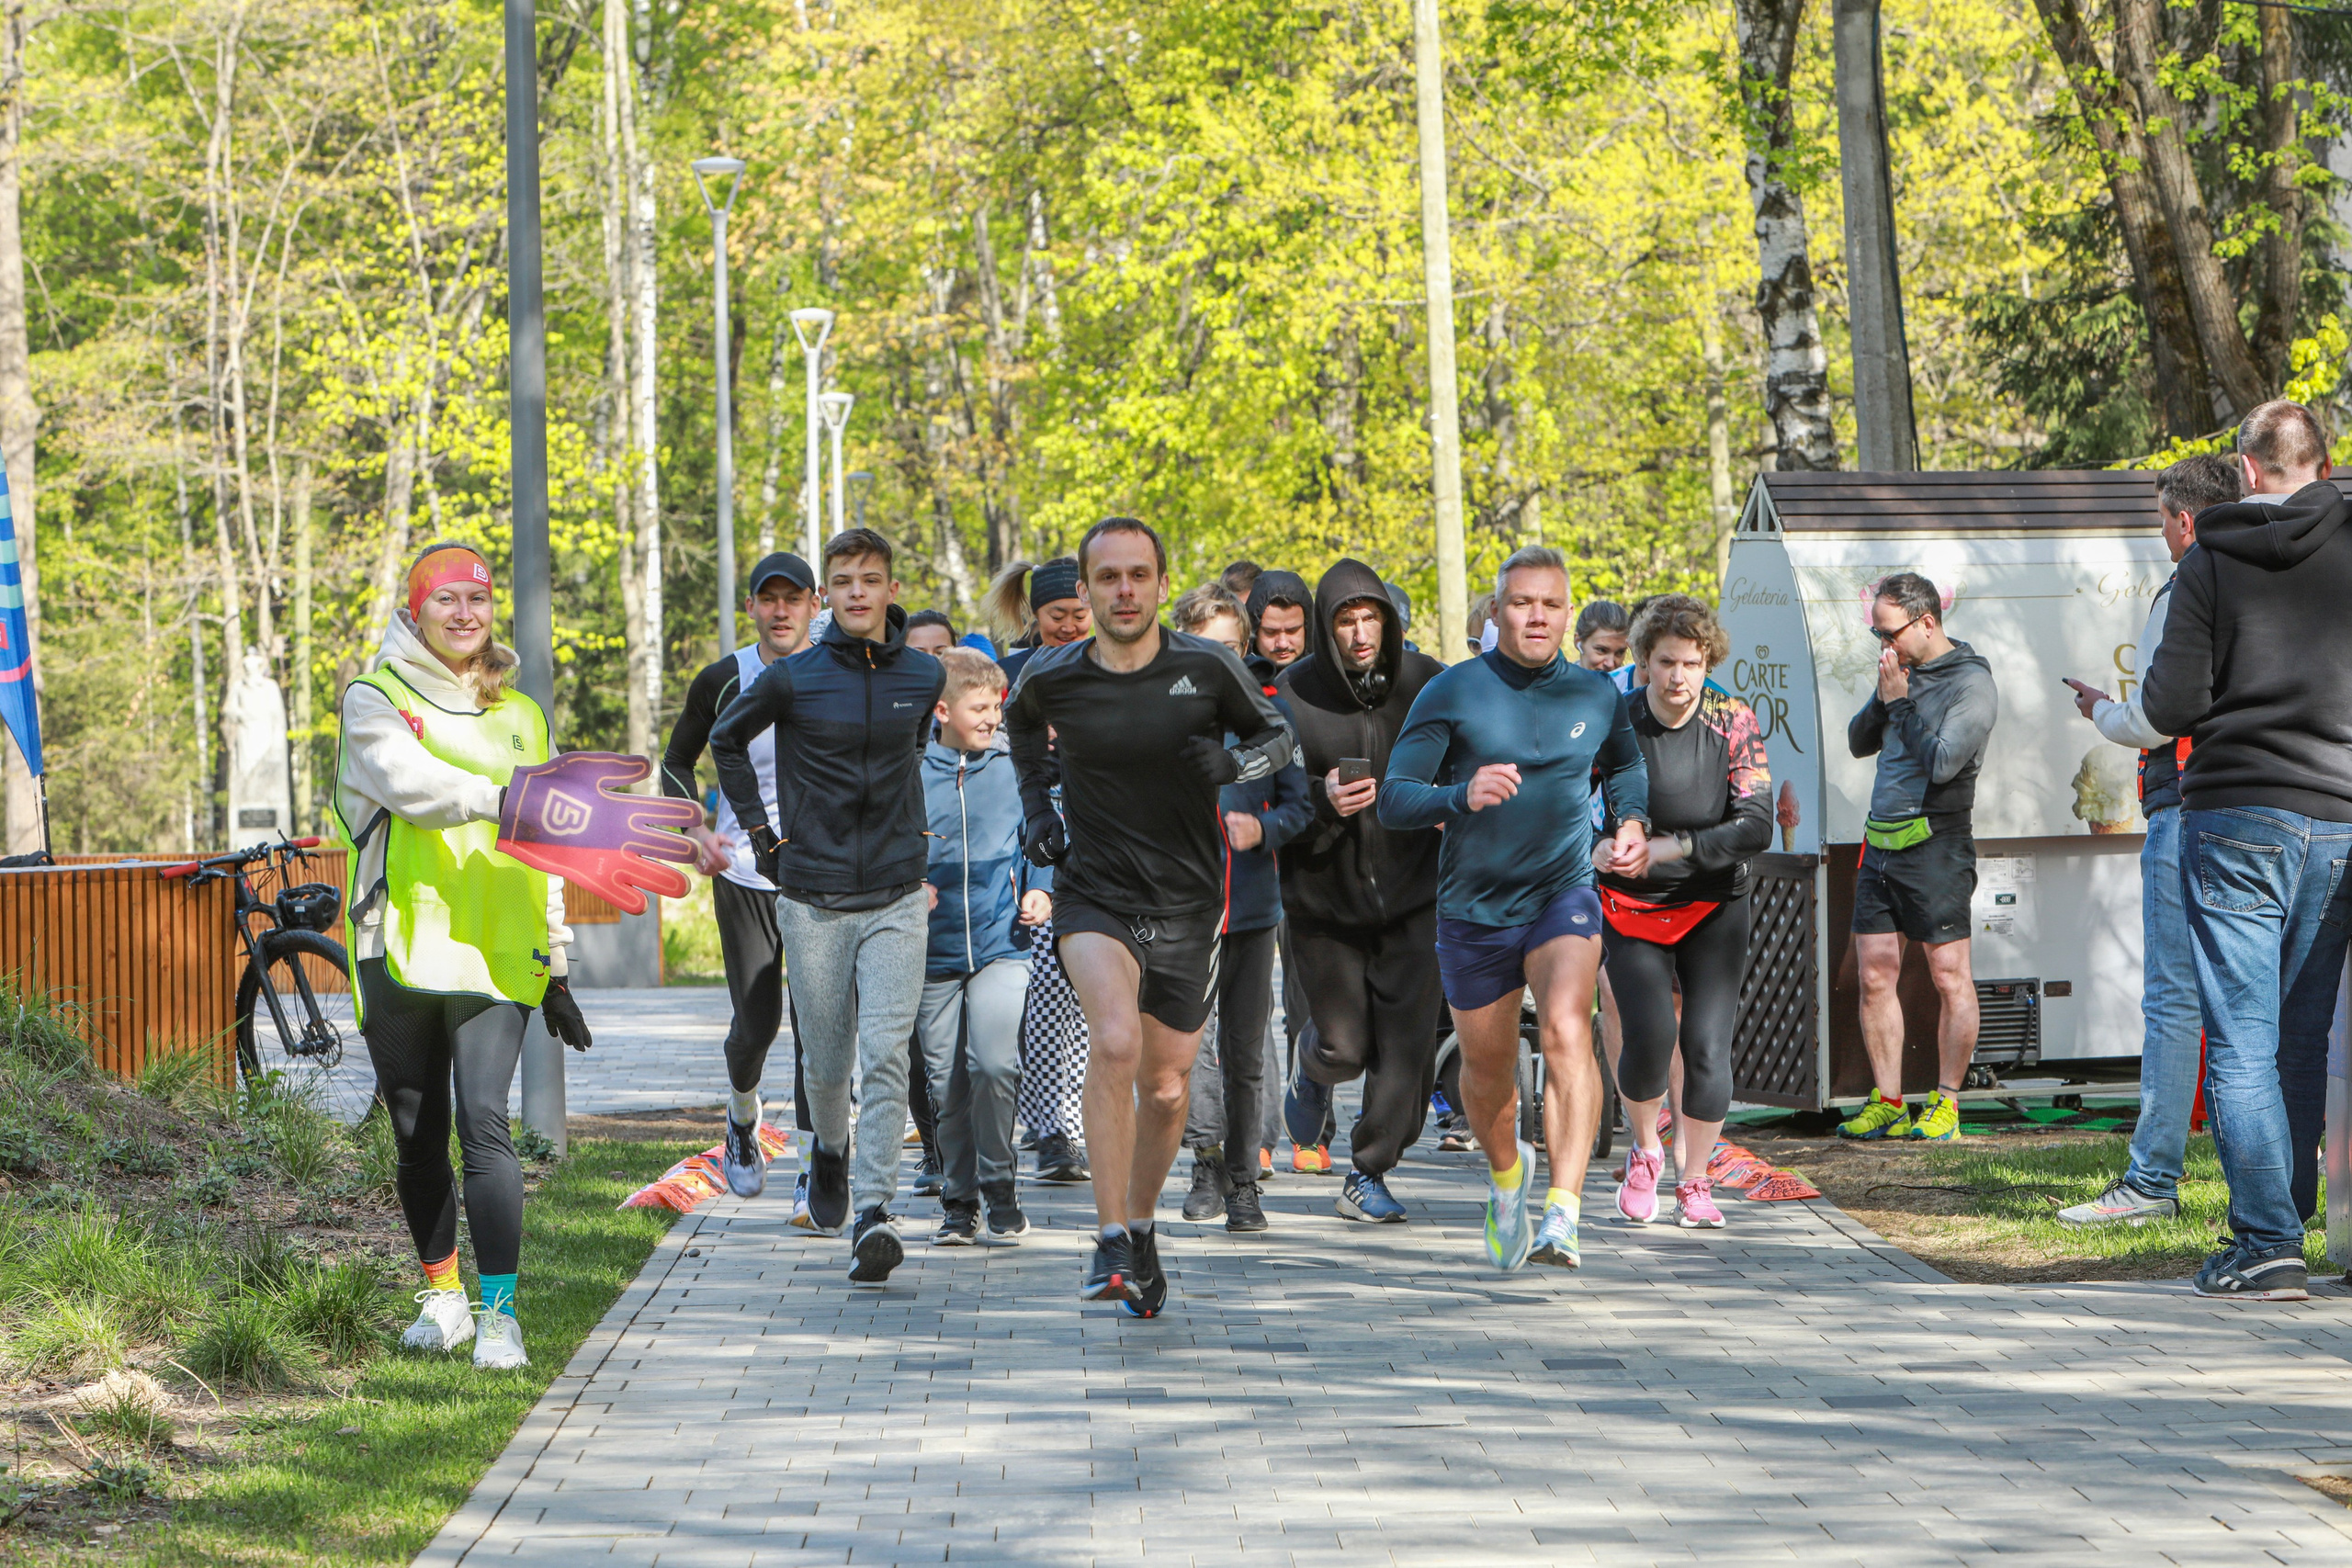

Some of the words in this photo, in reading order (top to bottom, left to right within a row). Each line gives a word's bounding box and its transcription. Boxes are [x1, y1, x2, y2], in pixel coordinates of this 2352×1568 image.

[1730, 576, 1789, 614] Gelateria
[1733, 659, 1789, 695] CARTE
[1733, 691, 1804, 754] 'OR
